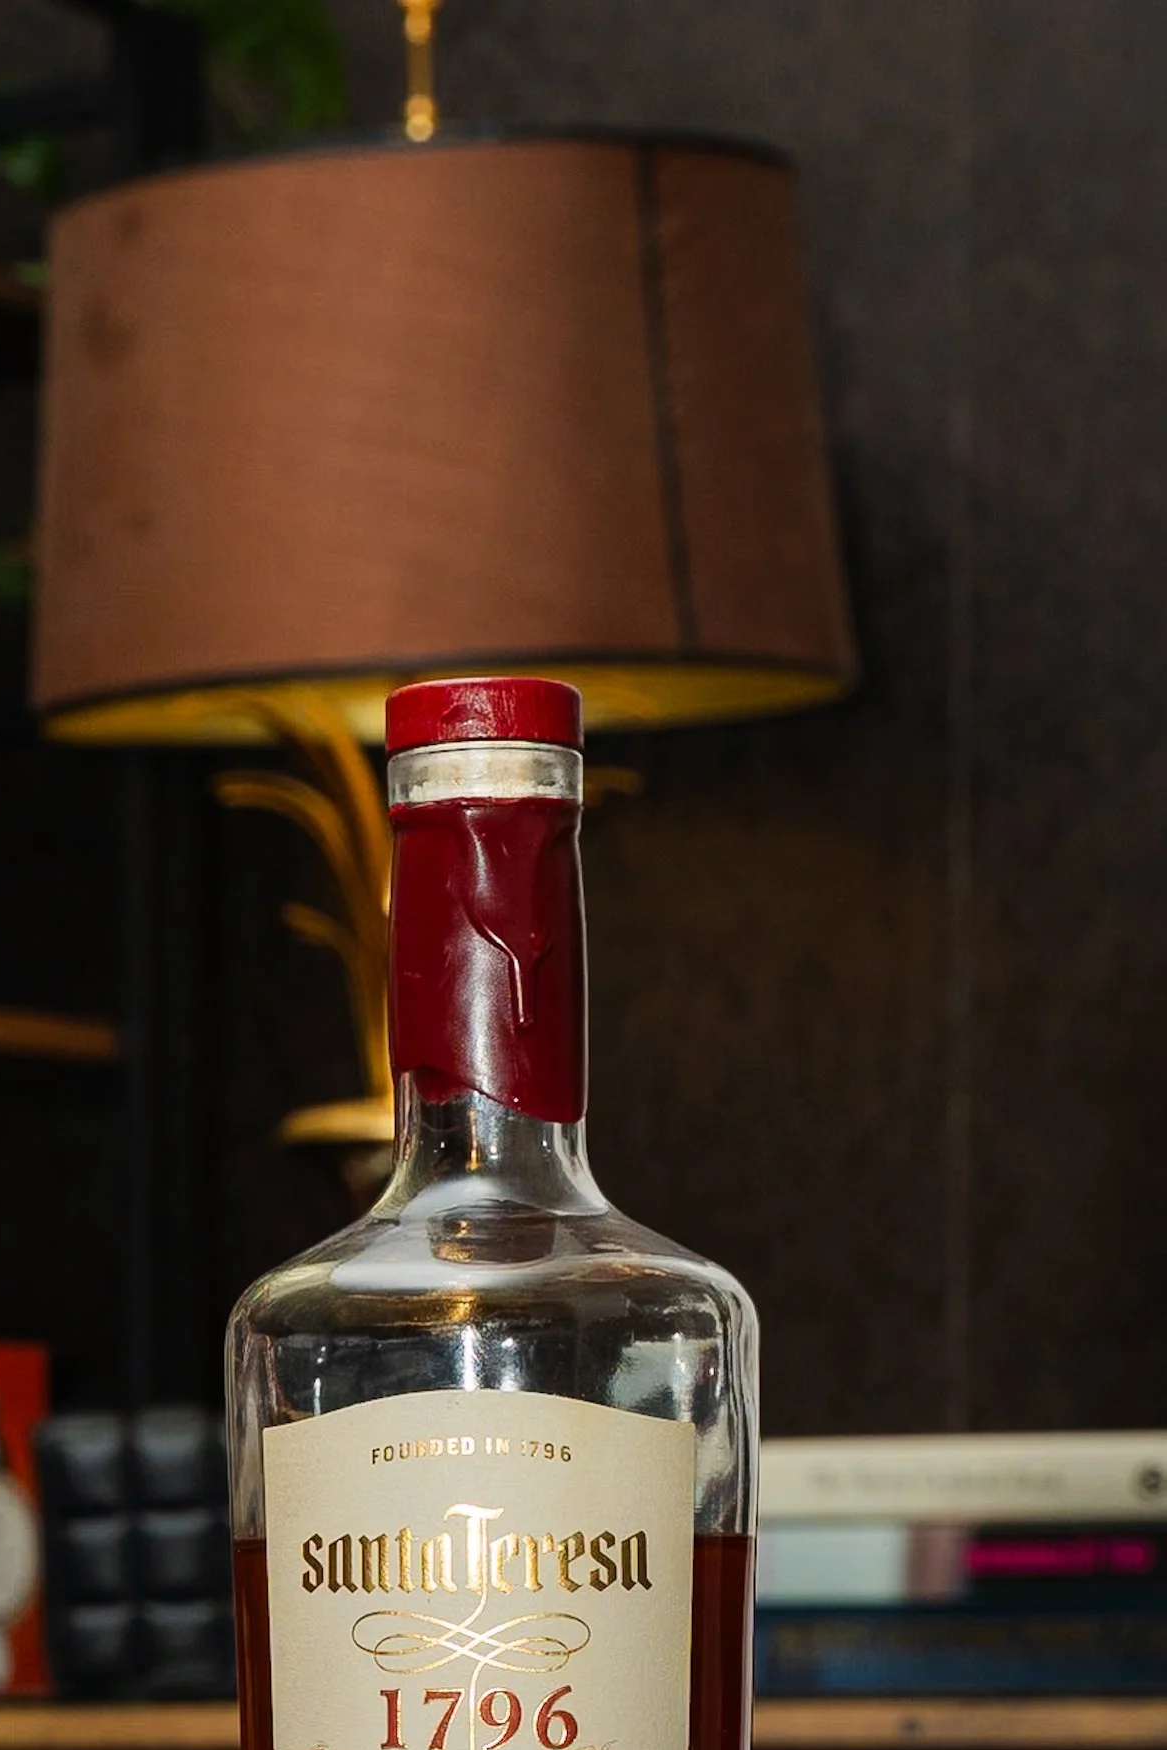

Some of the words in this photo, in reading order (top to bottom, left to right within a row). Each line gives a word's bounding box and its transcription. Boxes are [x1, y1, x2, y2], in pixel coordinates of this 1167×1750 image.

[372, 1436, 475, 1465] FOUNDED
[485, 1437, 510, 1456] IN
[520, 1440, 572, 1462] 1796
[302, 1527, 458, 1593] santa
[443, 1503, 653, 1595] Teresa
[380, 1685, 579, 1750] 1796
